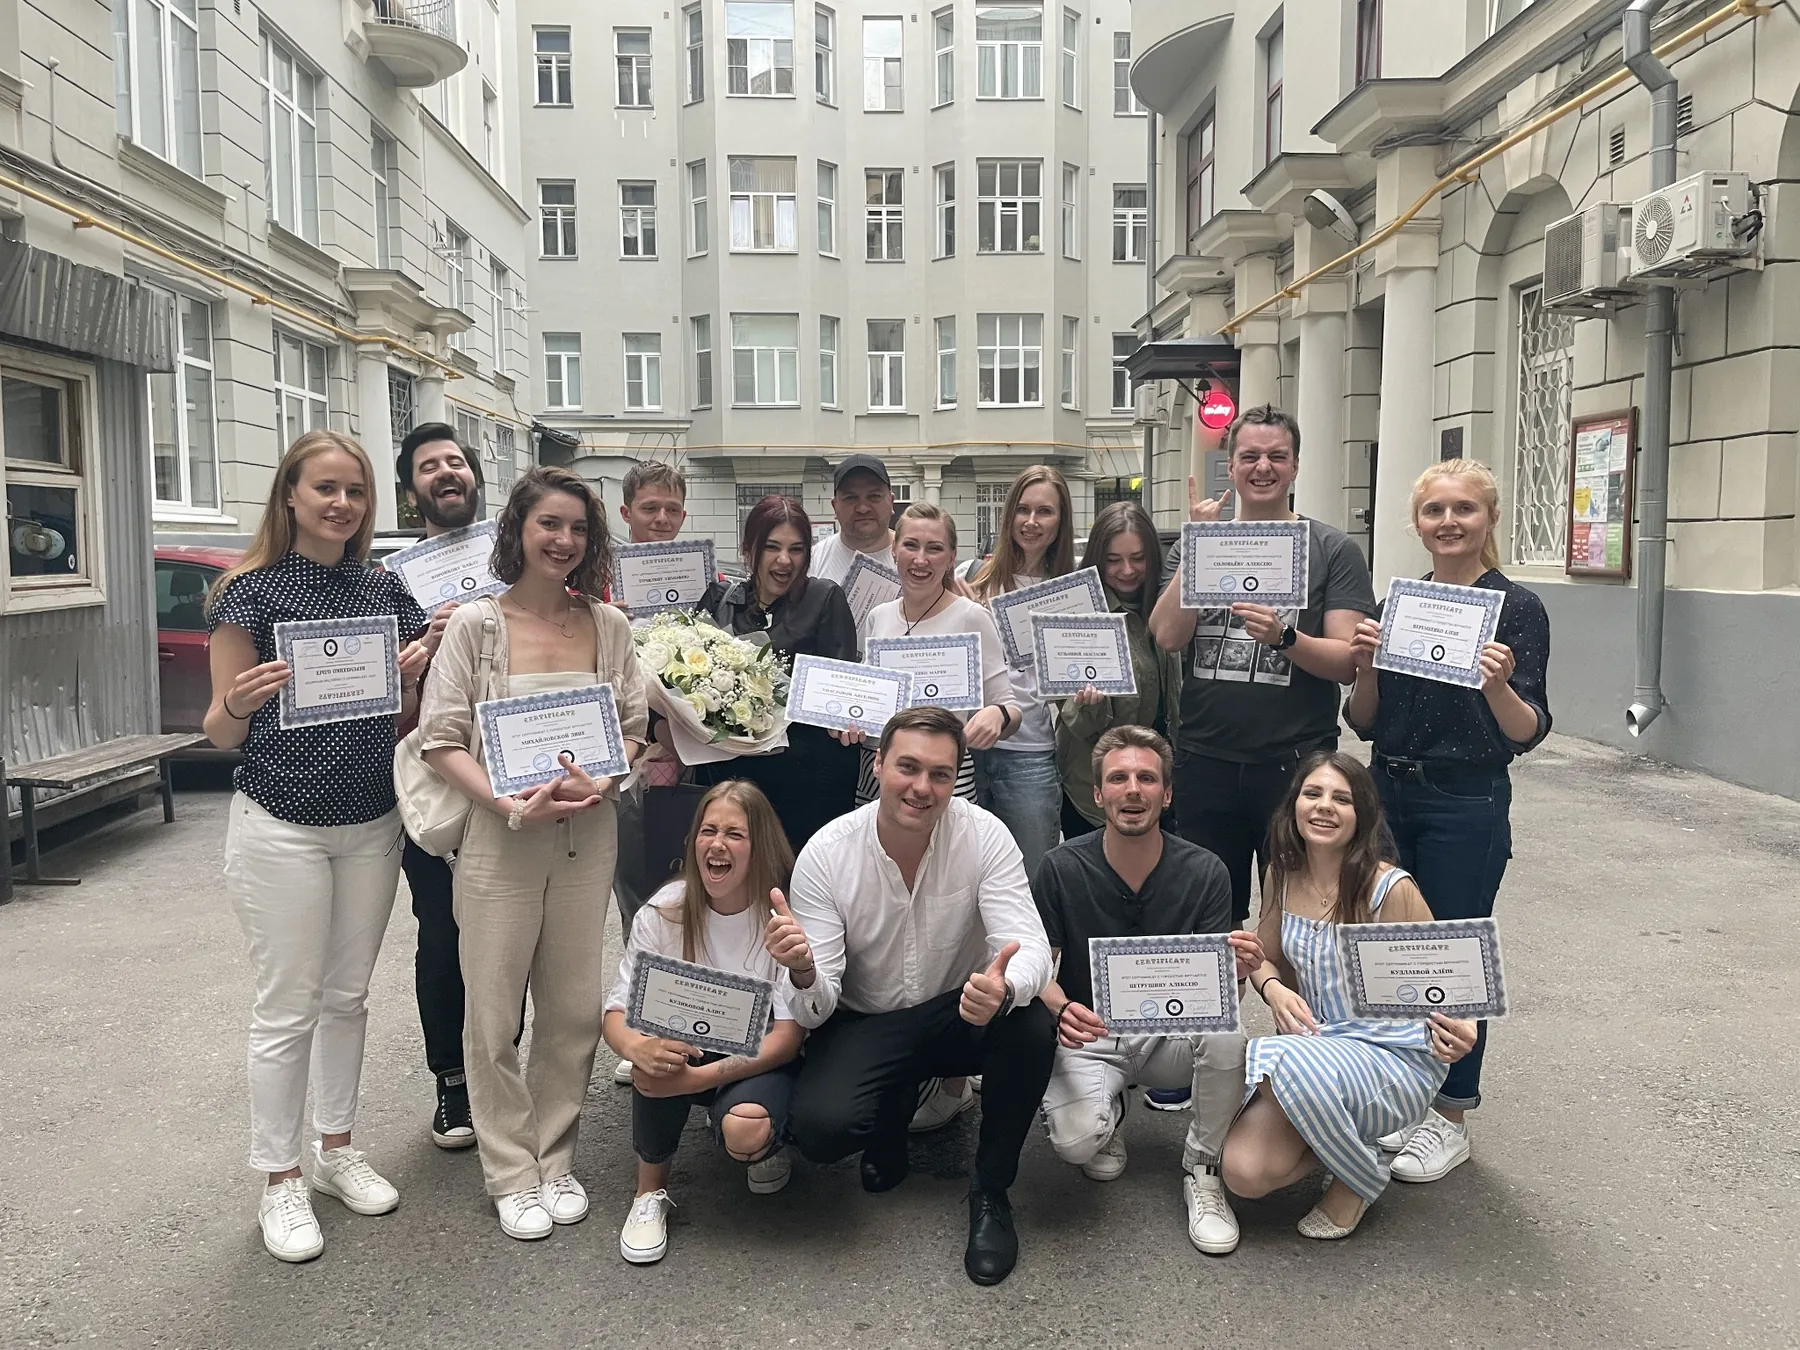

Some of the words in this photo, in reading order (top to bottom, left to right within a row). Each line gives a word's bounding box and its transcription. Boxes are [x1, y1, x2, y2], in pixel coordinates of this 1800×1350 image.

[1027, 594, 1069, 610] CERTIFICATE
[1419, 602, 1463, 614] CERTIFICATE
[524, 710, 576, 723] CERTIFICATE
[1389, 944, 1450, 952] CERTIFICATE
[1135, 958, 1190, 966] CERTIFICATE
[674, 979, 728, 997] CERTIFICATE
